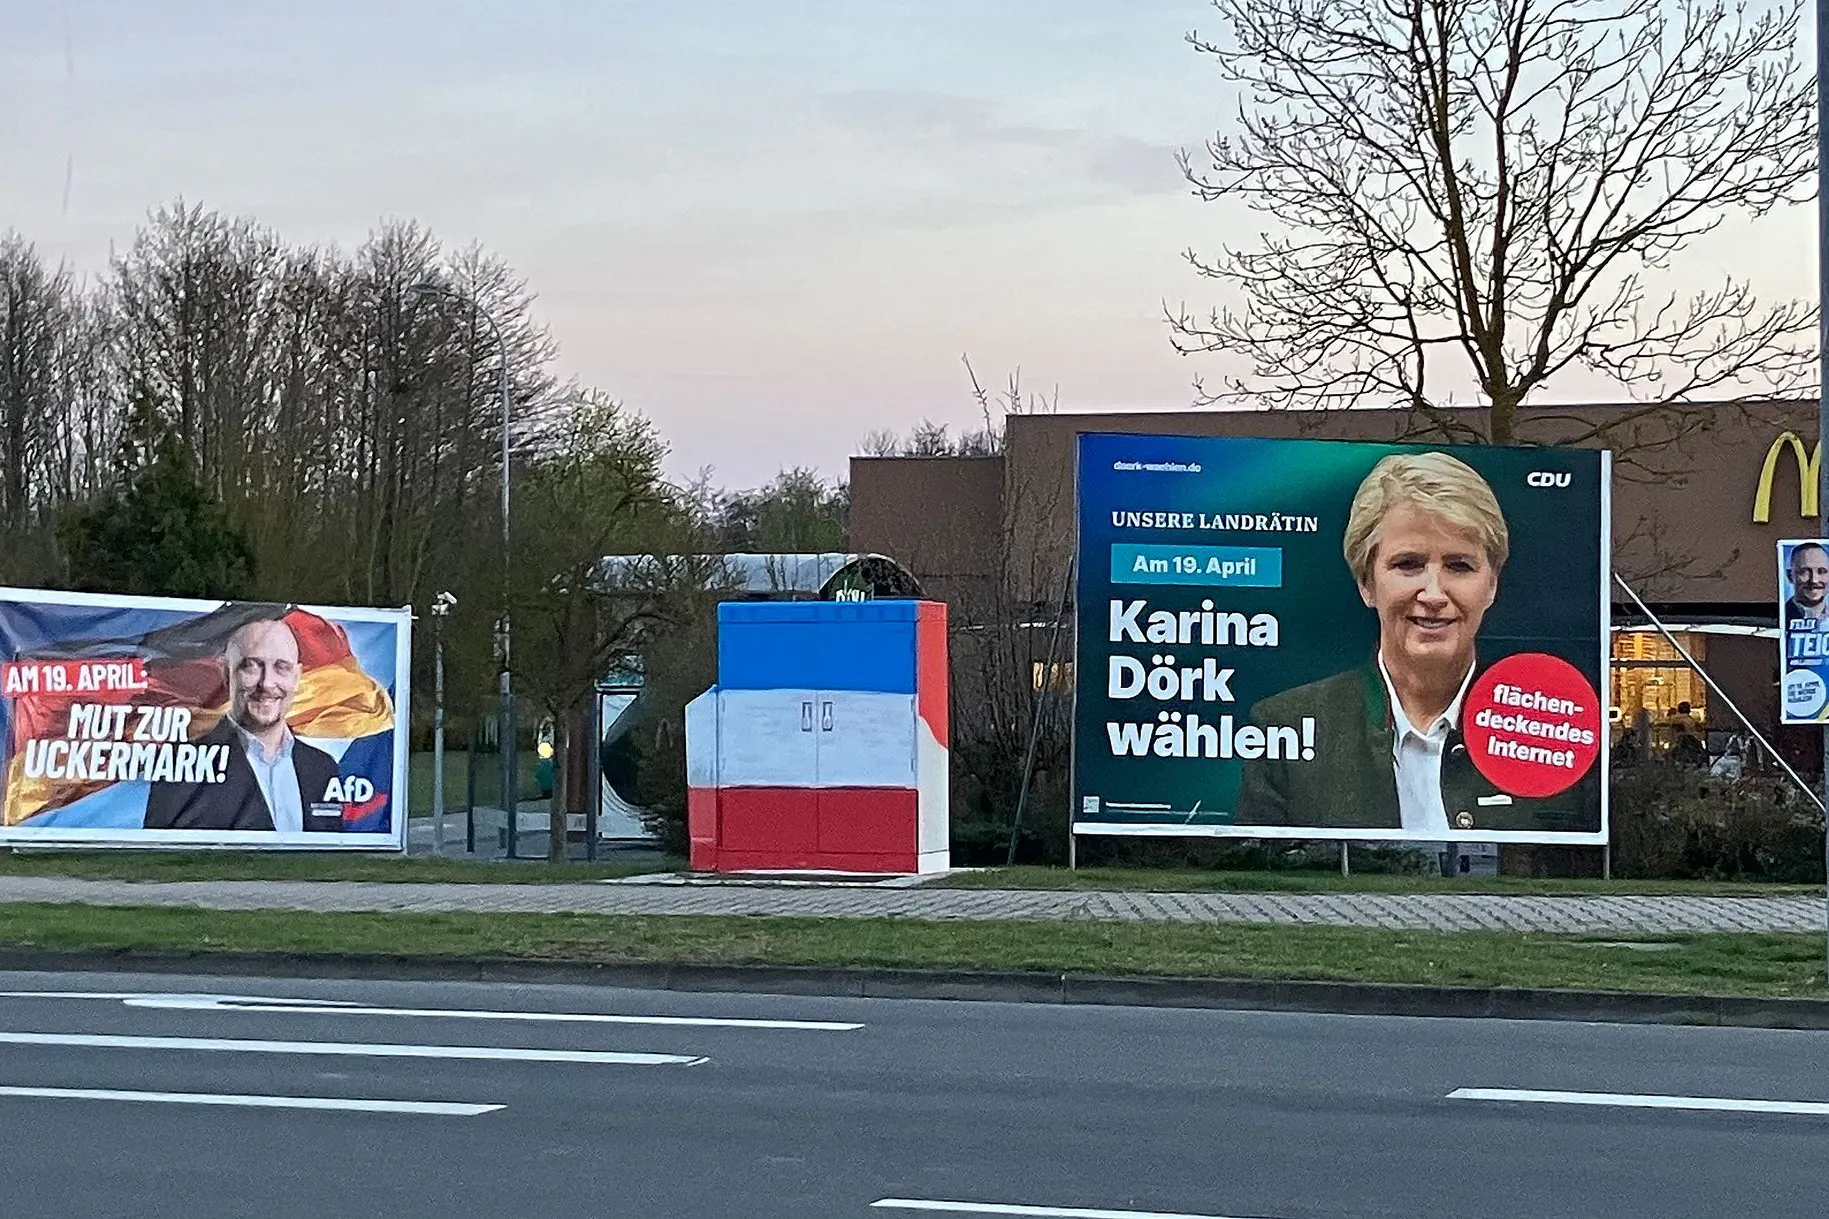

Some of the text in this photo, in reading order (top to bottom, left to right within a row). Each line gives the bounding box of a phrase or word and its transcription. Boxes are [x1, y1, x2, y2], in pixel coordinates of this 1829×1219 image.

[1527, 472, 1571, 488] CDU
[1112, 511, 1318, 532] UNSERE LANDRÄTIN
[1133, 555, 1256, 579] Am 19. April
[1109, 599, 1279, 647] Karina
[6, 663, 149, 694] AM 19. APRIL:
[1108, 654, 1235, 702] Dörk
[1493, 683, 1585, 716] flächen-
[67, 703, 192, 742] MUT ZUR
[1106, 711, 1316, 761] wählen!
[1475, 709, 1594, 745] deckendes
[24, 739, 230, 784] UCKERMARK!
[1487, 736, 1576, 769] Internet
[323, 775, 374, 803] AfD
